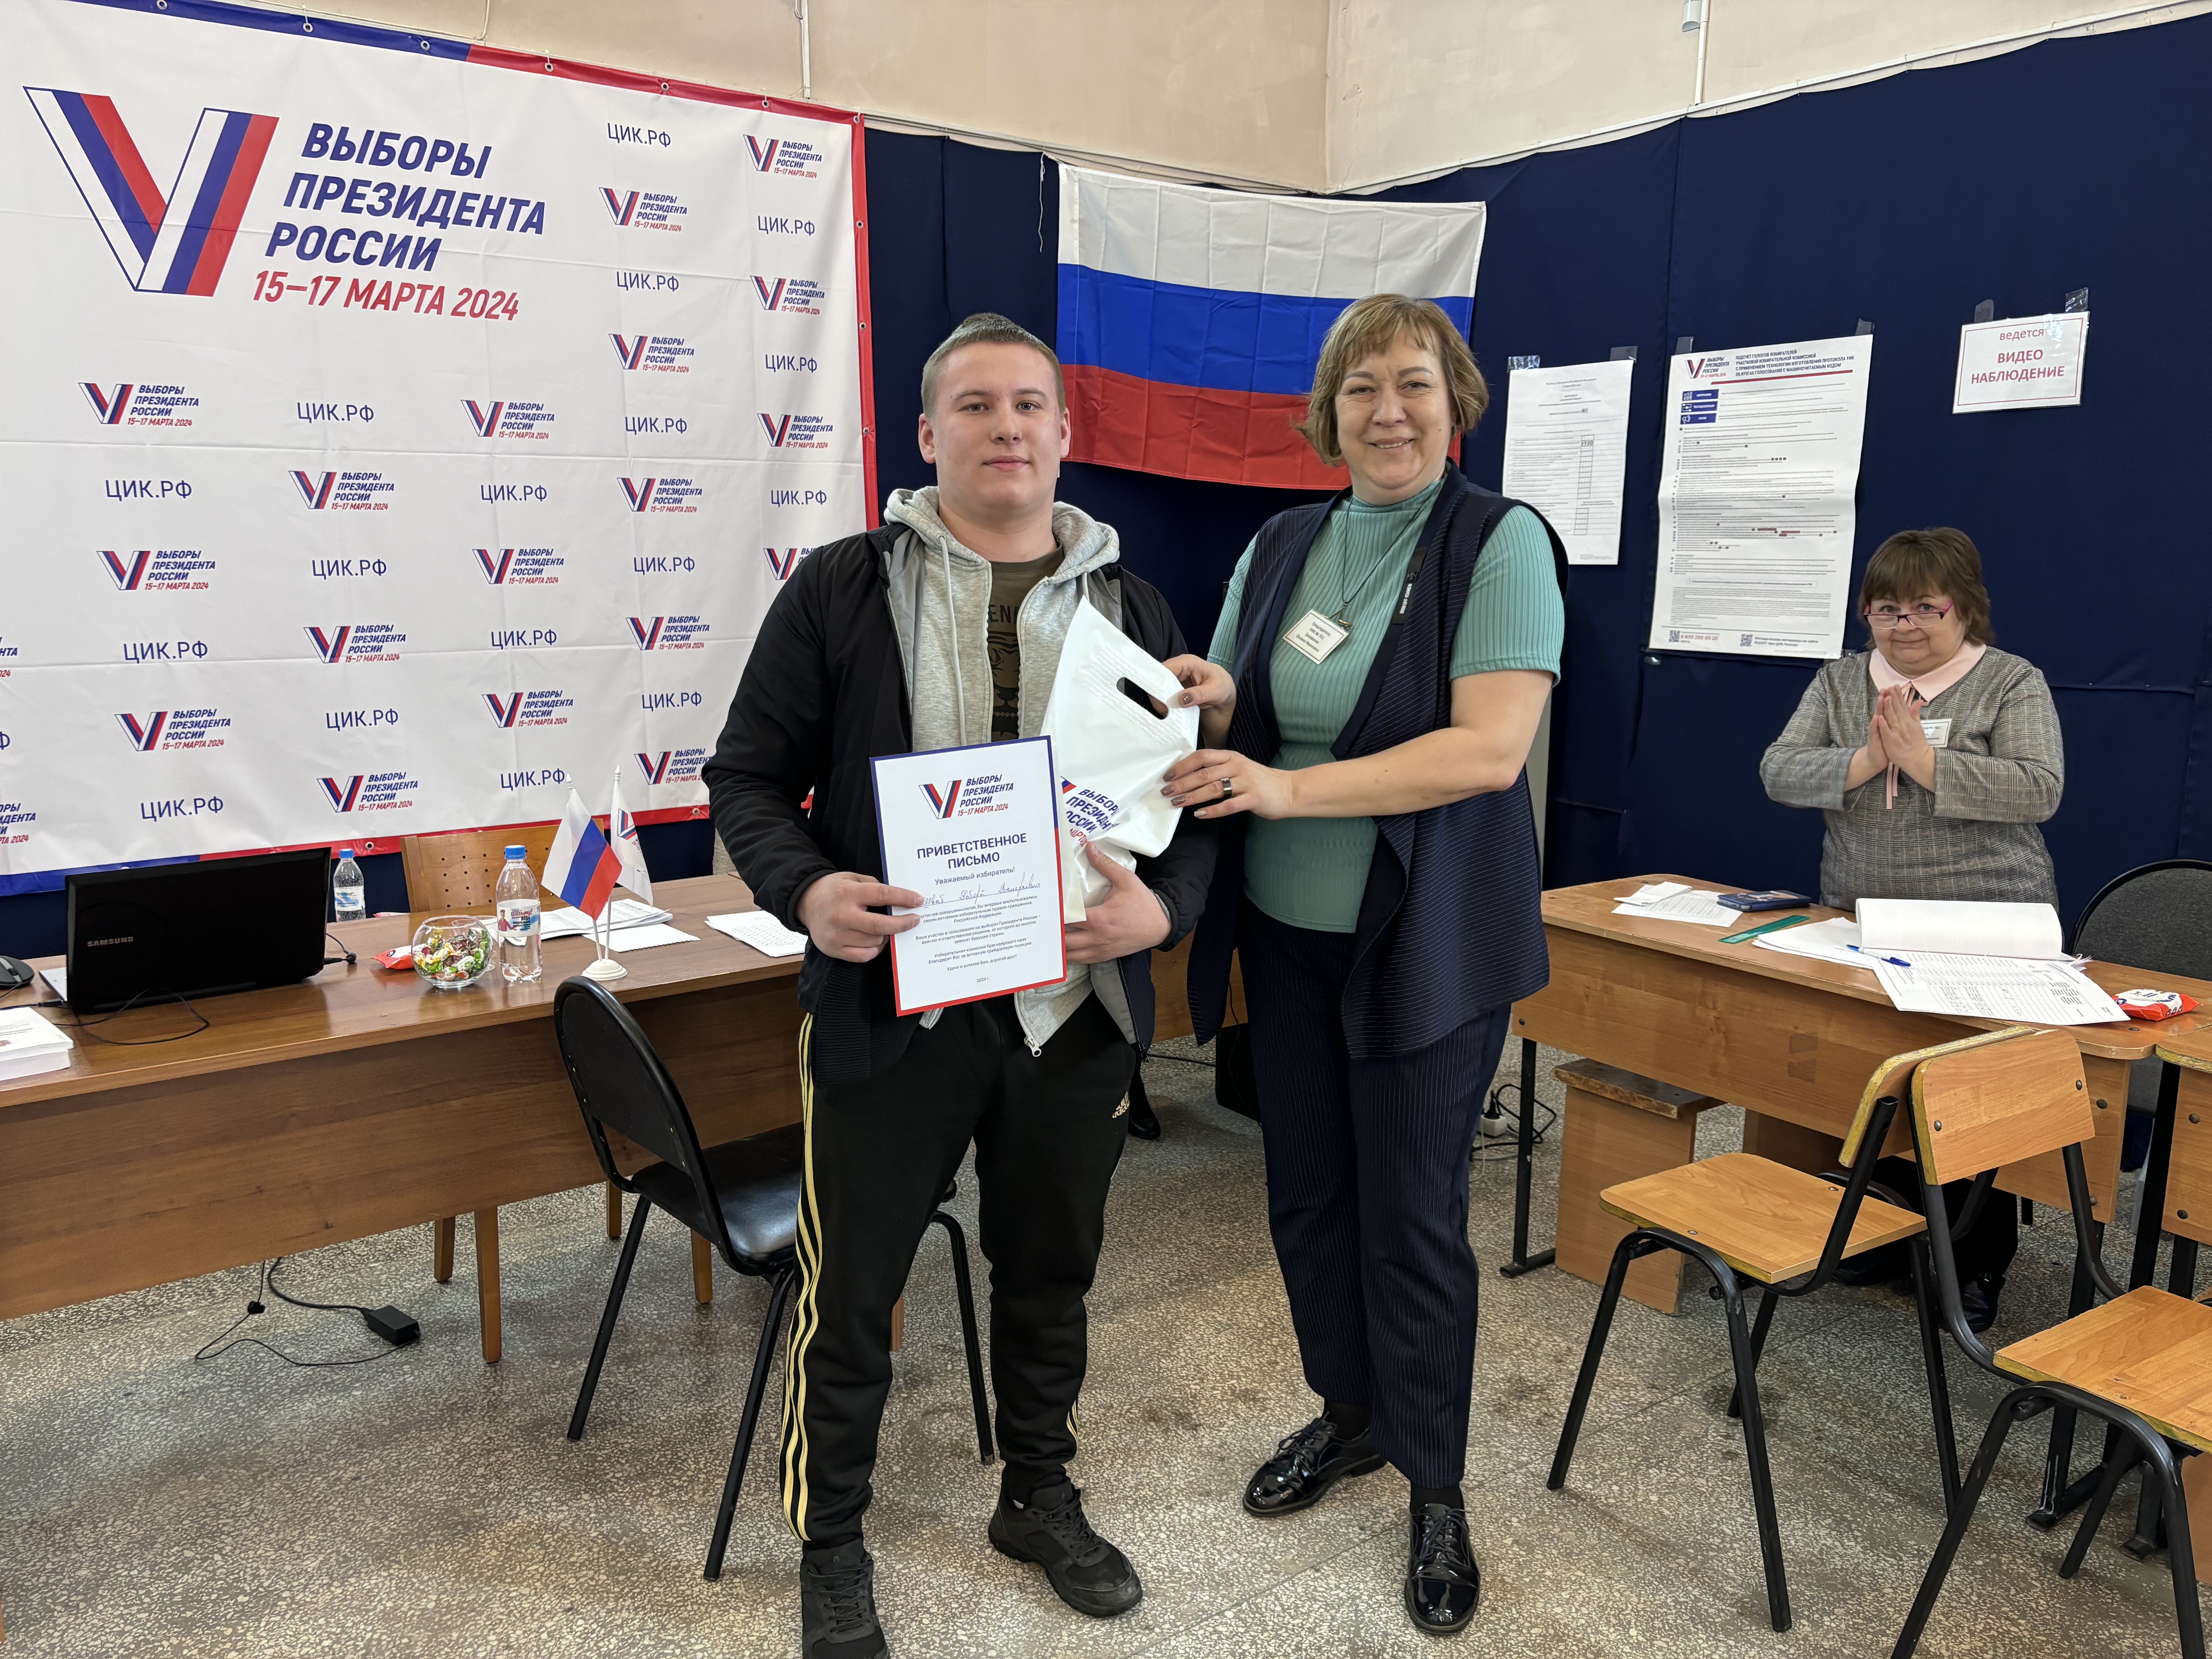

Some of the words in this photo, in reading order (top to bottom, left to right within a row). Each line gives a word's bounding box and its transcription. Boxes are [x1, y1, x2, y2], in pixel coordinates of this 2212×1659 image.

[608, 123, 670, 147] ЦИК.РФ
[301, 123, 492, 179] ВЫБОРЫ
[782, 141, 812, 151] ВЫБОРЫ
[779, 150, 822, 162] ПРЕЗИДЕНТА
[776, 159, 804, 168] РОССИИ
[283, 172, 545, 235] ПРЕЗИДЕНТА
[644, 193, 677, 204] ВЫБОРЫ
[640, 202, 687, 215] ПРЕЗИДЕНТА
[637, 211, 667, 222] РОССИИ
[758, 216, 815, 236] ЦИК.РФ
[265, 222, 442, 271] РОССИИ
[617, 271, 678, 292] ЦИК.РФ
[343, 278, 445, 315] МАРТА
[451, 288, 519, 320] 2024
[2000, 329, 2044, 341] ведется
[766, 354, 817, 373] ЦИК.РФ
[1998, 349, 2043, 364] ВИДЕО
[1972, 366, 2064, 384] НАБЛЮДЕНИЕ
[139, 385, 185, 394] ВЫБОРЫ
[134, 396, 199, 407] ПРЕЗИДЕНТА
[508, 402, 544, 411] ВЫБОРЫ
[130, 407, 172, 416] РОССИИ
[297, 402, 373, 423] ЦИК.РФ
[505, 412, 555, 422] ПРЕЗИДЕНТА
[501, 422, 534, 430] РОССИИ
[625, 417, 687, 435] ЦИК.РФ
[341, 472, 382, 481] ВЫБОРЫ
[106, 480, 191, 501] ЦИК.РФ
[338, 483, 394, 492] ПРЕЗИДЕНТА
[481, 485, 547, 504] ЦИК.РФ
[334, 493, 371, 501] РОССИИ
[771, 490, 826, 507] ЦИК.РФ
[152, 561, 215, 570] ПРЕЗИДЕНТА
[312, 559, 386, 580] ЦИК.РФ
[634, 557, 695, 575] ЦИК.РФ
[148, 572, 189, 580] РОССИИ
[491, 629, 556, 650] ЦИК.РФ
[124, 641, 208, 664] ЦИК.РФ
[642, 692, 701, 712] ЦИК.РФ
[173, 709, 217, 719] ВЫБОРЫ
[326, 708, 398, 731] ЦИК.РФ
[169, 718, 230, 730] ПРЕЗИДЕНТА
[165, 730, 205, 740] РОССИИ
[182, 740, 206, 749] МАРТА
[501, 768, 565, 791] ЦИК.РФ
[966, 775, 1002, 786] ВЫБОРЫ
[963, 783, 1013, 797] ПРЕЗИДЕНТА
[960, 796, 993, 807] РОССИИ
[141, 796, 223, 822] ЦИК.РФ
[974, 805, 993, 814] МАРТА
[917, 833, 1027, 859] ПРИВЕТСТВЕННОЕ
[948, 852, 1000, 869] ПИСЬМО
[935, 874, 974, 885] Уважаемый
[977, 867, 1015, 878] избиратель!
[87, 937, 133, 947] SAMSUNG
